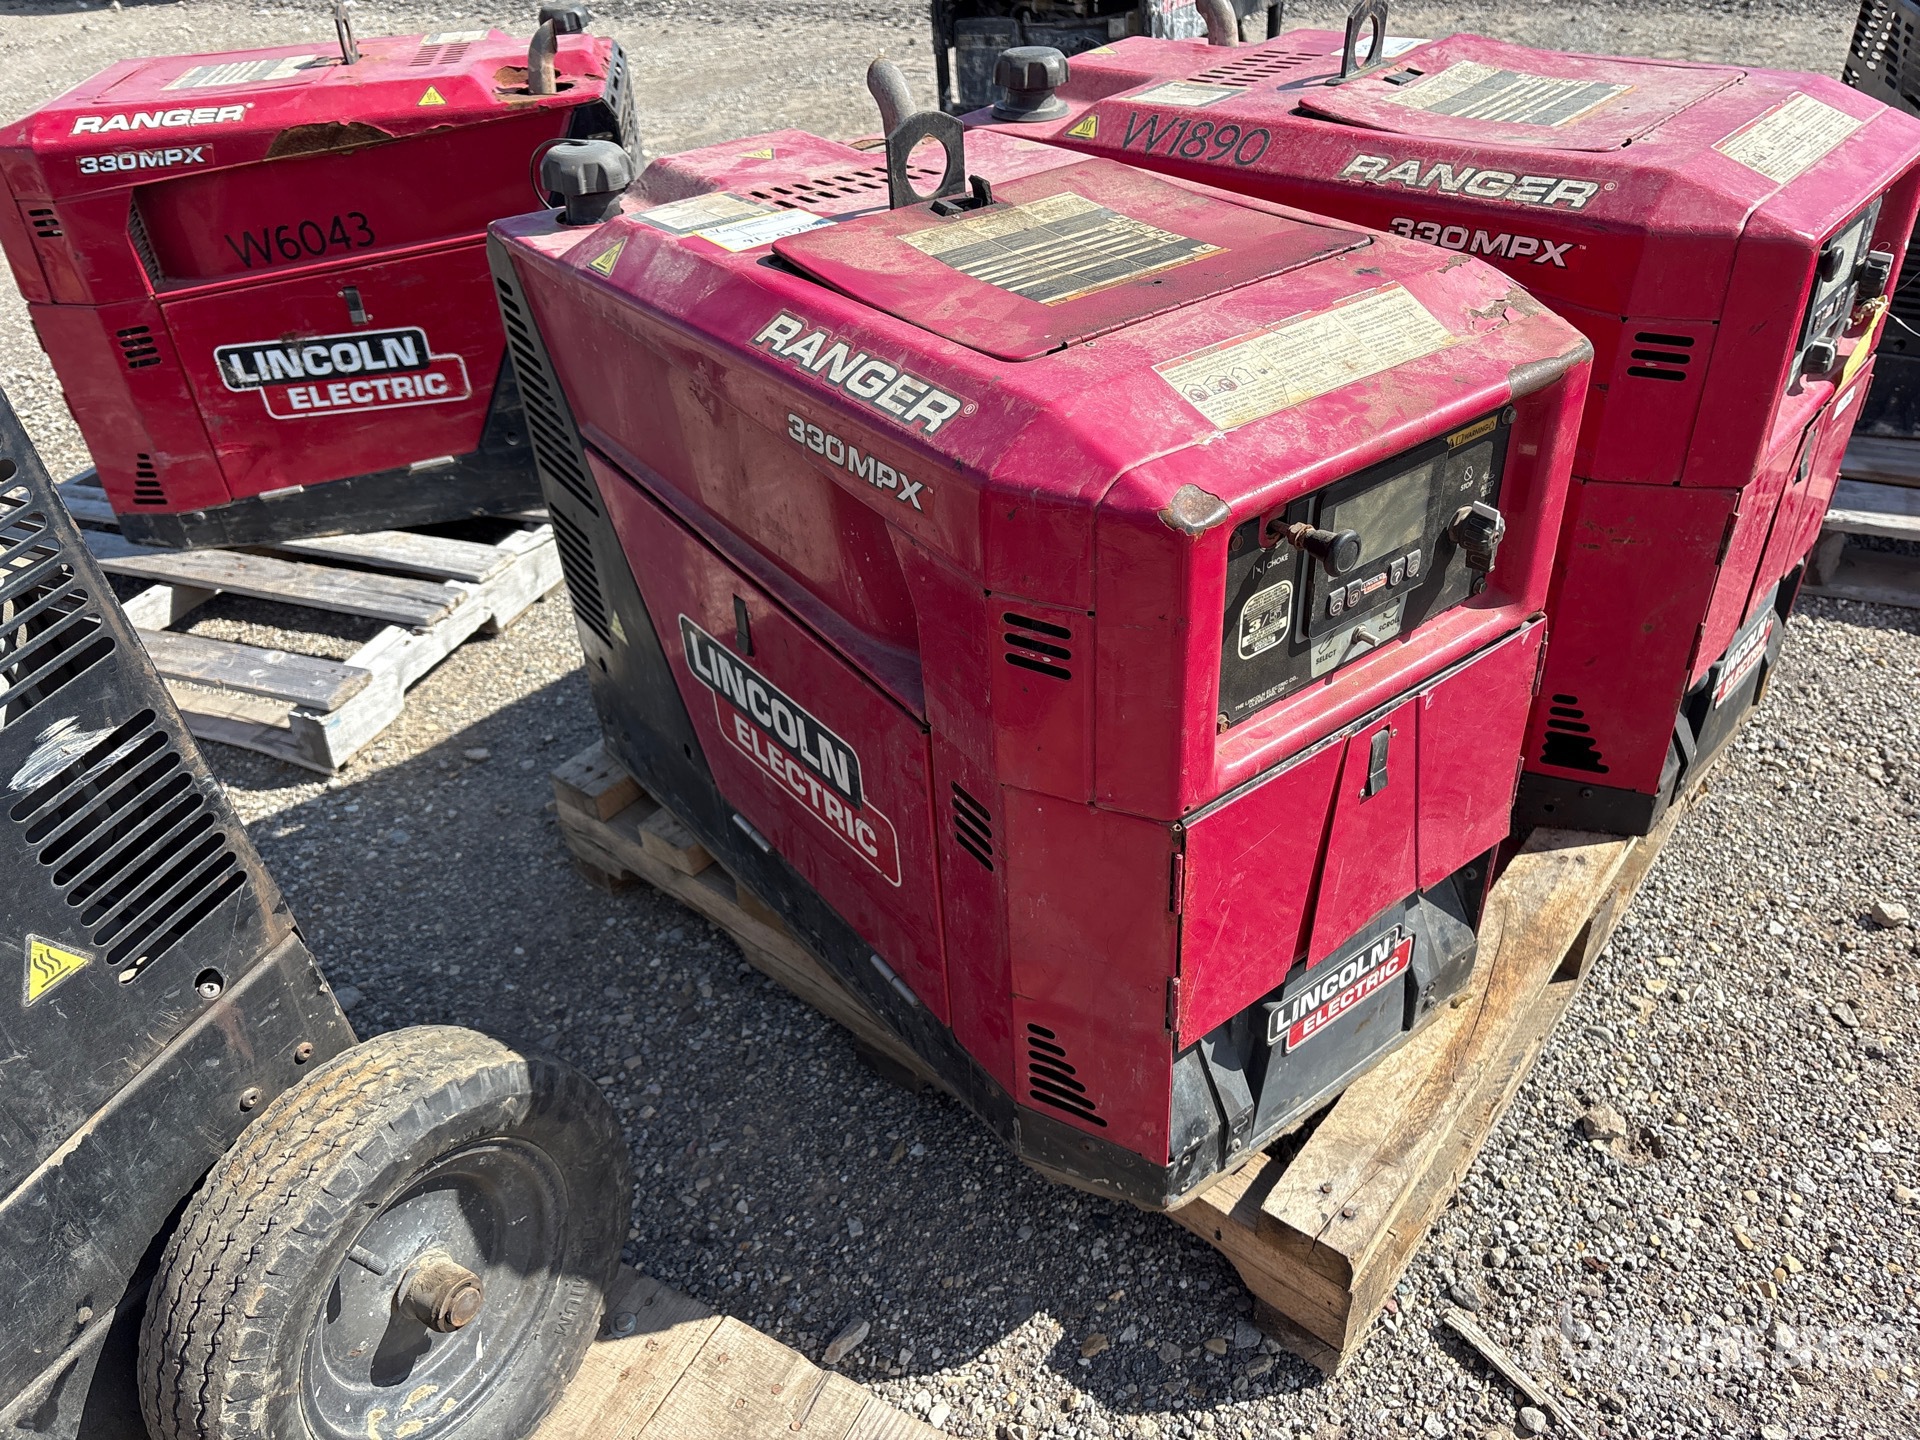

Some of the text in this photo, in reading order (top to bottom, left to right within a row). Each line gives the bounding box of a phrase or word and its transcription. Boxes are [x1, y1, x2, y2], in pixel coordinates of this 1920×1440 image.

[70, 103, 245, 136] RANGER
[1121, 111, 1271, 167] W1890
[79, 145, 205, 175] 330MPX
[1340, 153, 1599, 210] RANGER
[225, 210, 375, 269] W6043
[229, 336, 416, 385] LINCOLN
[752, 312, 961, 436] RANGER
[287, 373, 448, 411] ELECTRIC
[1464, 424, 1490, 441] WARNING
[786, 412, 924, 511] 330MPX
[1460, 481, 1474, 492] STOP
[1266, 553, 1290, 570] CHOKE
[1378, 615, 1401, 632] SCROLL
[1315, 648, 1337, 665] SELECT
[1717, 616, 1768, 687] LINCOLN
[689, 630, 852, 797] LINCOLN
[1235, 702, 1245, 711] THE
[733, 712, 878, 859] ELECTRIC
[1275, 936, 1390, 1033] LINCOLN
[1302, 956, 1400, 1037] ELECTRIC
